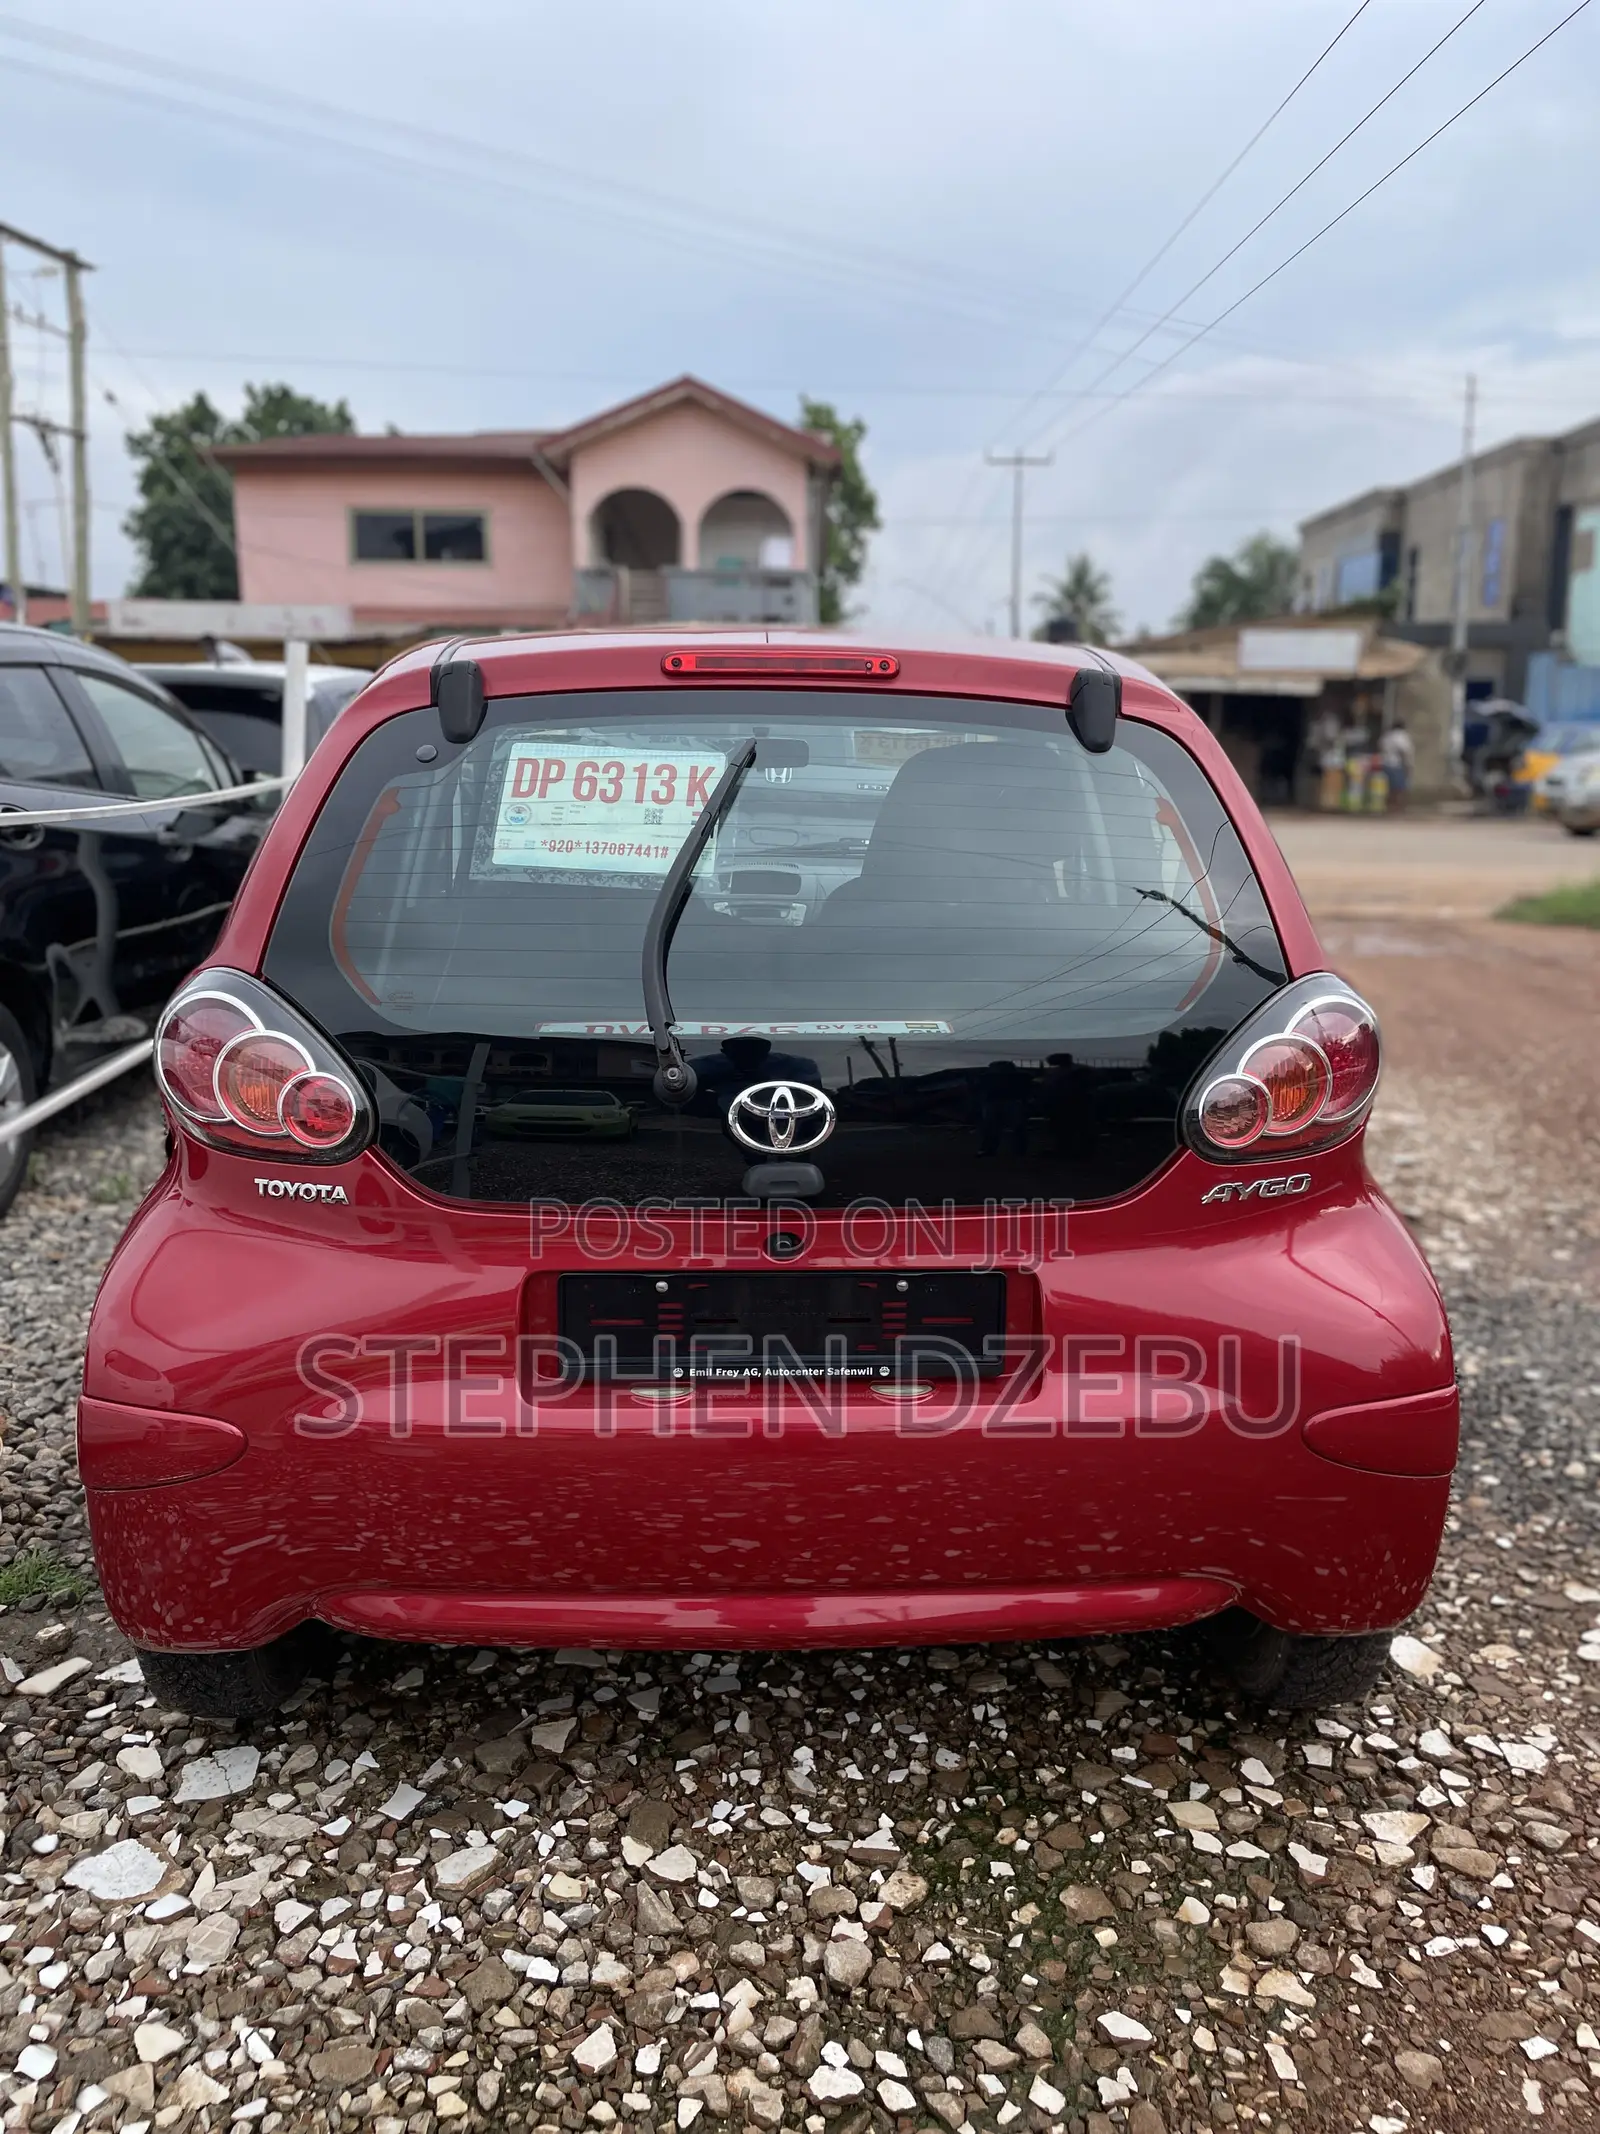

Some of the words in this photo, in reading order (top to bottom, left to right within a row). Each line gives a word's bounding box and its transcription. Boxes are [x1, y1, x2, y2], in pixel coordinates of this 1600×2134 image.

[510, 757, 566, 799] DP
[572, 760, 678, 806] 6313
[685, 765, 716, 807] K
[254, 1178, 349, 1205] TOYOTA
[1201, 1173, 1311, 1204] AYGO
[689, 1368, 712, 1376] Emil
[716, 1368, 739, 1378] Frey
[743, 1368, 761, 1377] AG,
[765, 1368, 823, 1376] Autocenter
[827, 1367, 873, 1376] Safenwil
